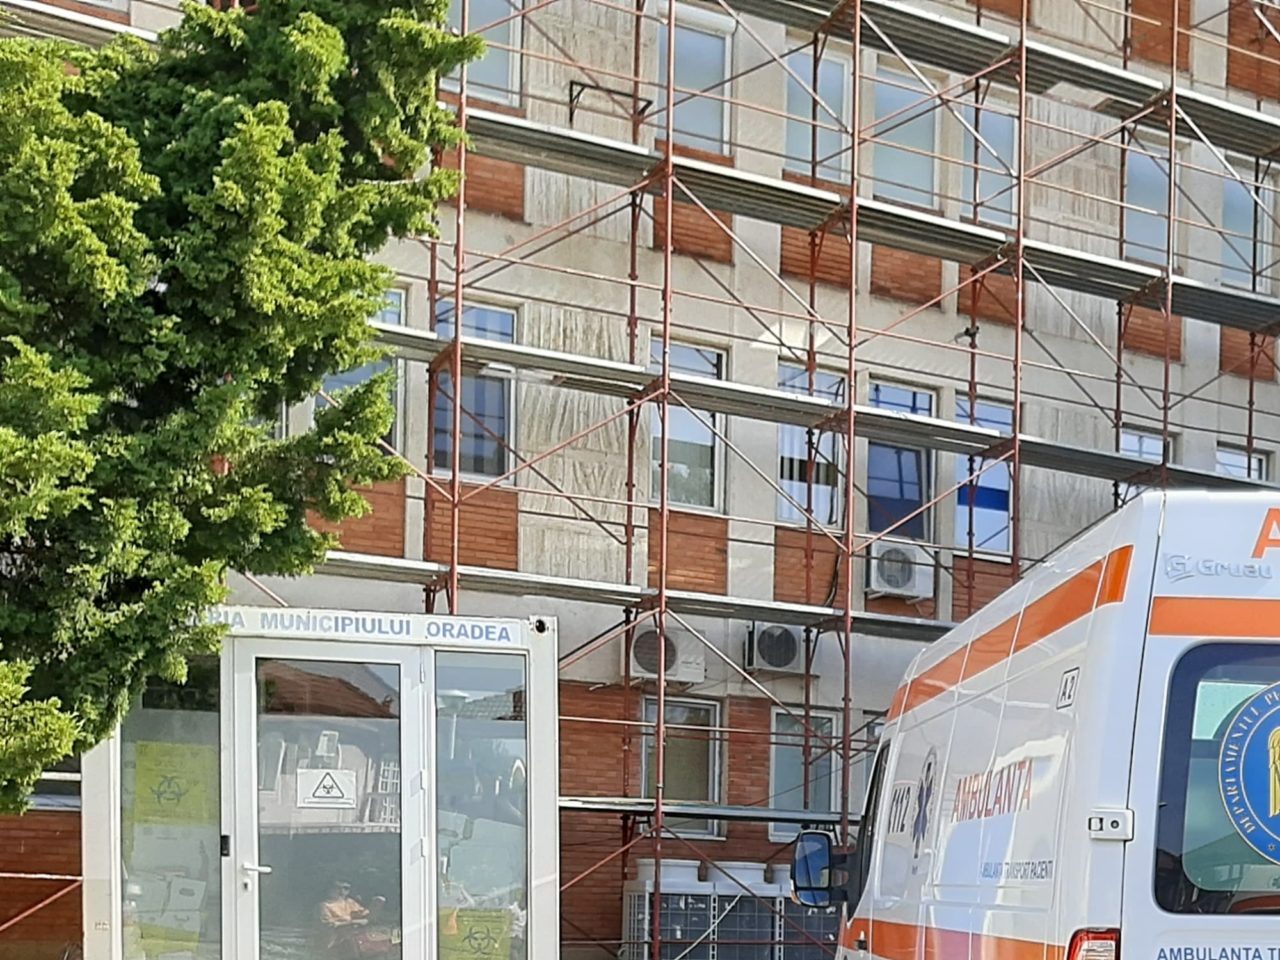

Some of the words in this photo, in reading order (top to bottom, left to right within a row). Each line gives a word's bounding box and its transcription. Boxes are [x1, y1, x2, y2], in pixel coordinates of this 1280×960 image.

[1197, 559, 1273, 581] Gruau
[260, 612, 411, 636] MUNICIPIULUI
[426, 621, 511, 642] ORADEA
[951, 757, 1034, 825] AMBULANTA
